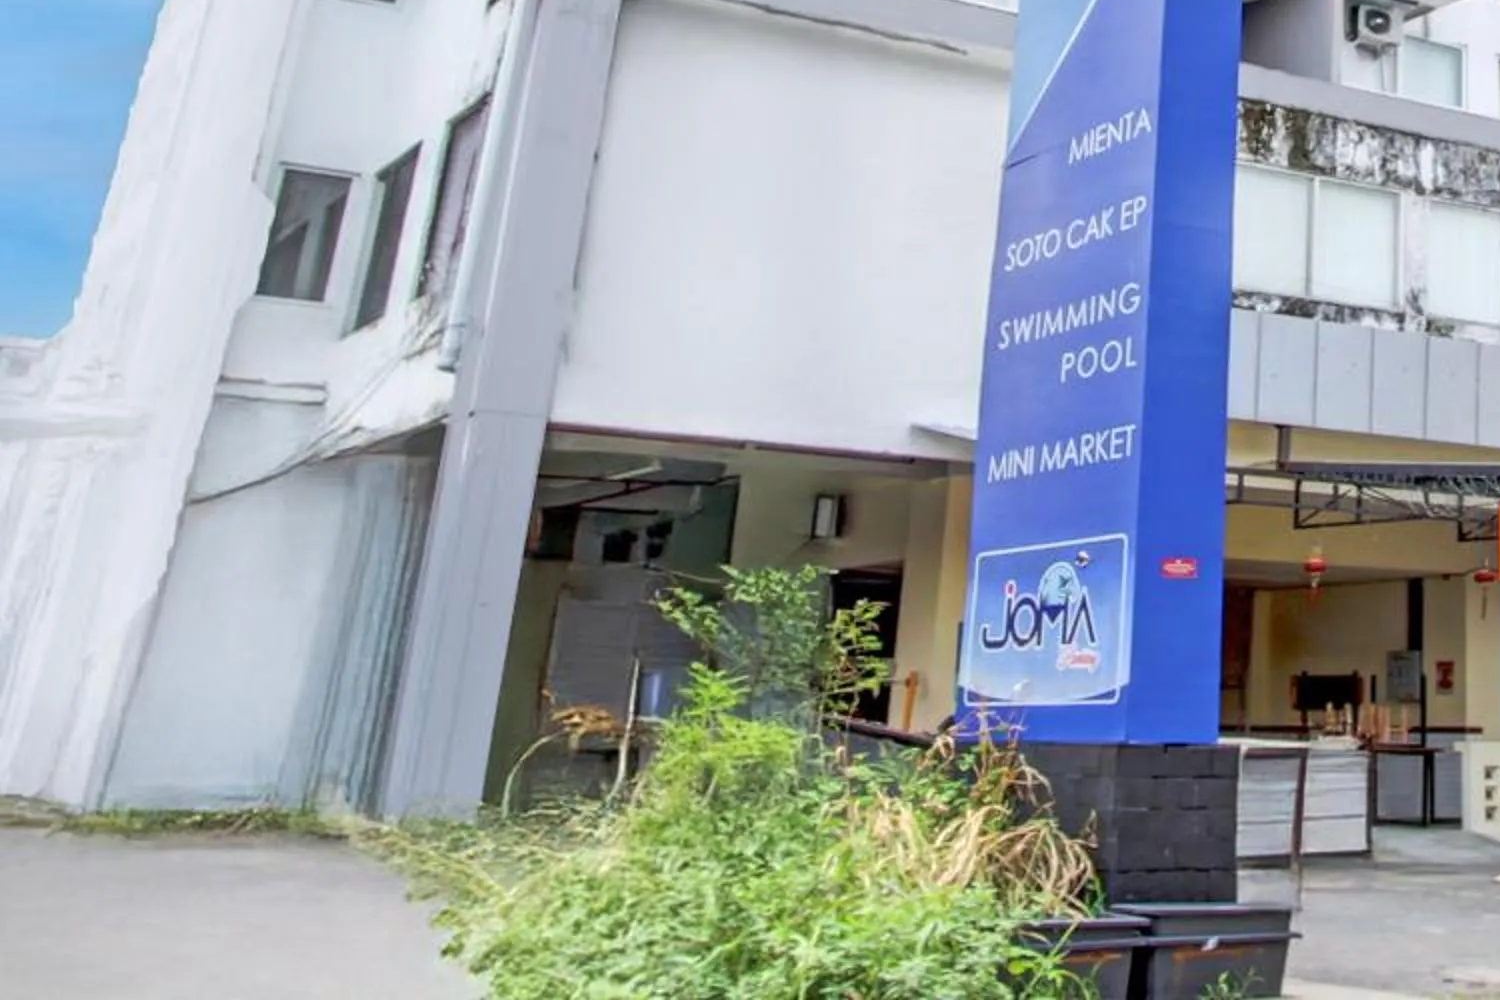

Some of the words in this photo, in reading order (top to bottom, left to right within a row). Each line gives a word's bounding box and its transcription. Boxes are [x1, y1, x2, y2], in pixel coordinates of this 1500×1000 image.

[1068, 107, 1152, 165] MIENTA
[1004, 228, 1062, 272] SOTO
[1066, 205, 1115, 249] CAK
[1119, 196, 1147, 231] EP
[997, 282, 1141, 350] SWIMMING
[1060, 336, 1137, 384] POOL
[987, 445, 1035, 484] MINI
[1039, 424, 1136, 473] MARKET
